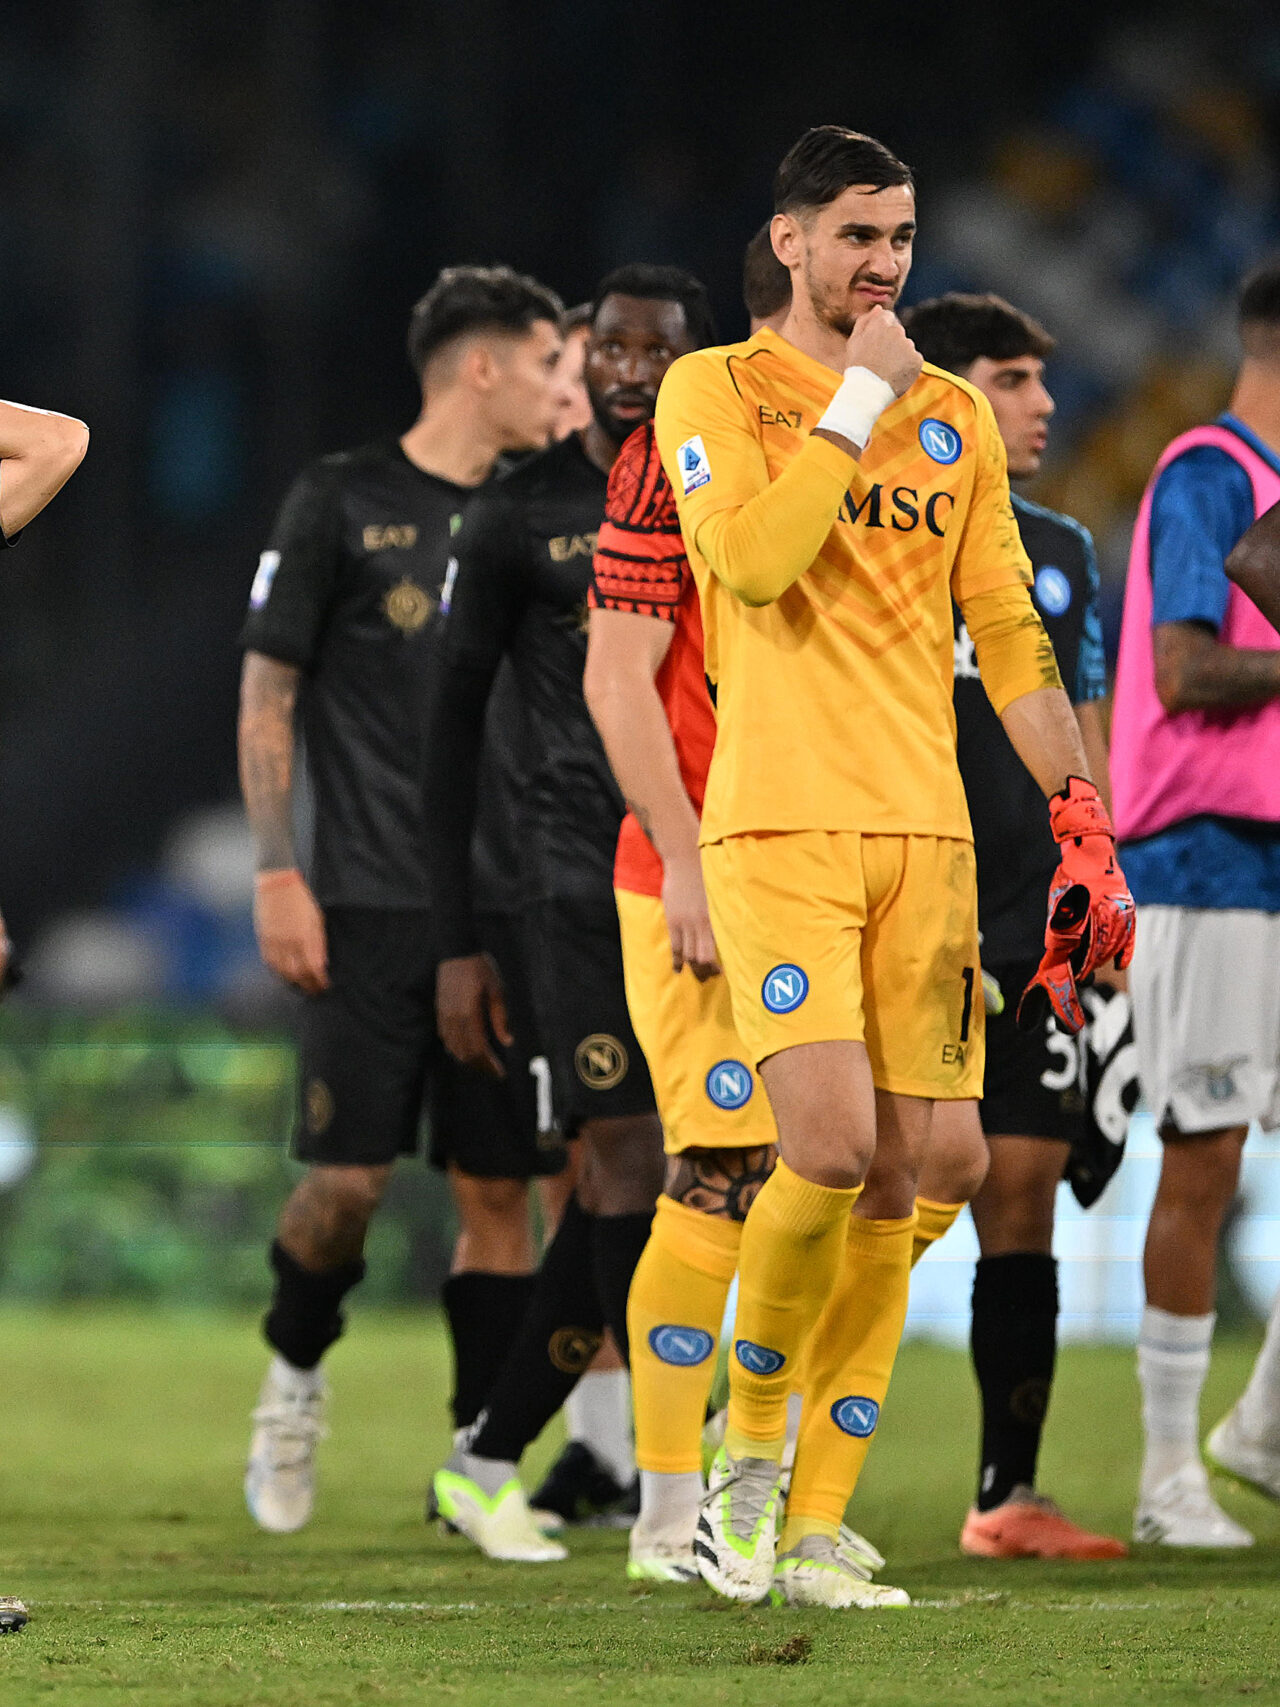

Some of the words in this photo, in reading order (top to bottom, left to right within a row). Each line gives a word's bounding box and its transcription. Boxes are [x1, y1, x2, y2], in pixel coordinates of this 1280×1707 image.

[759, 404, 803, 429] EA7
[837, 483, 956, 538] MSC
[960, 966, 975, 1042] 1
